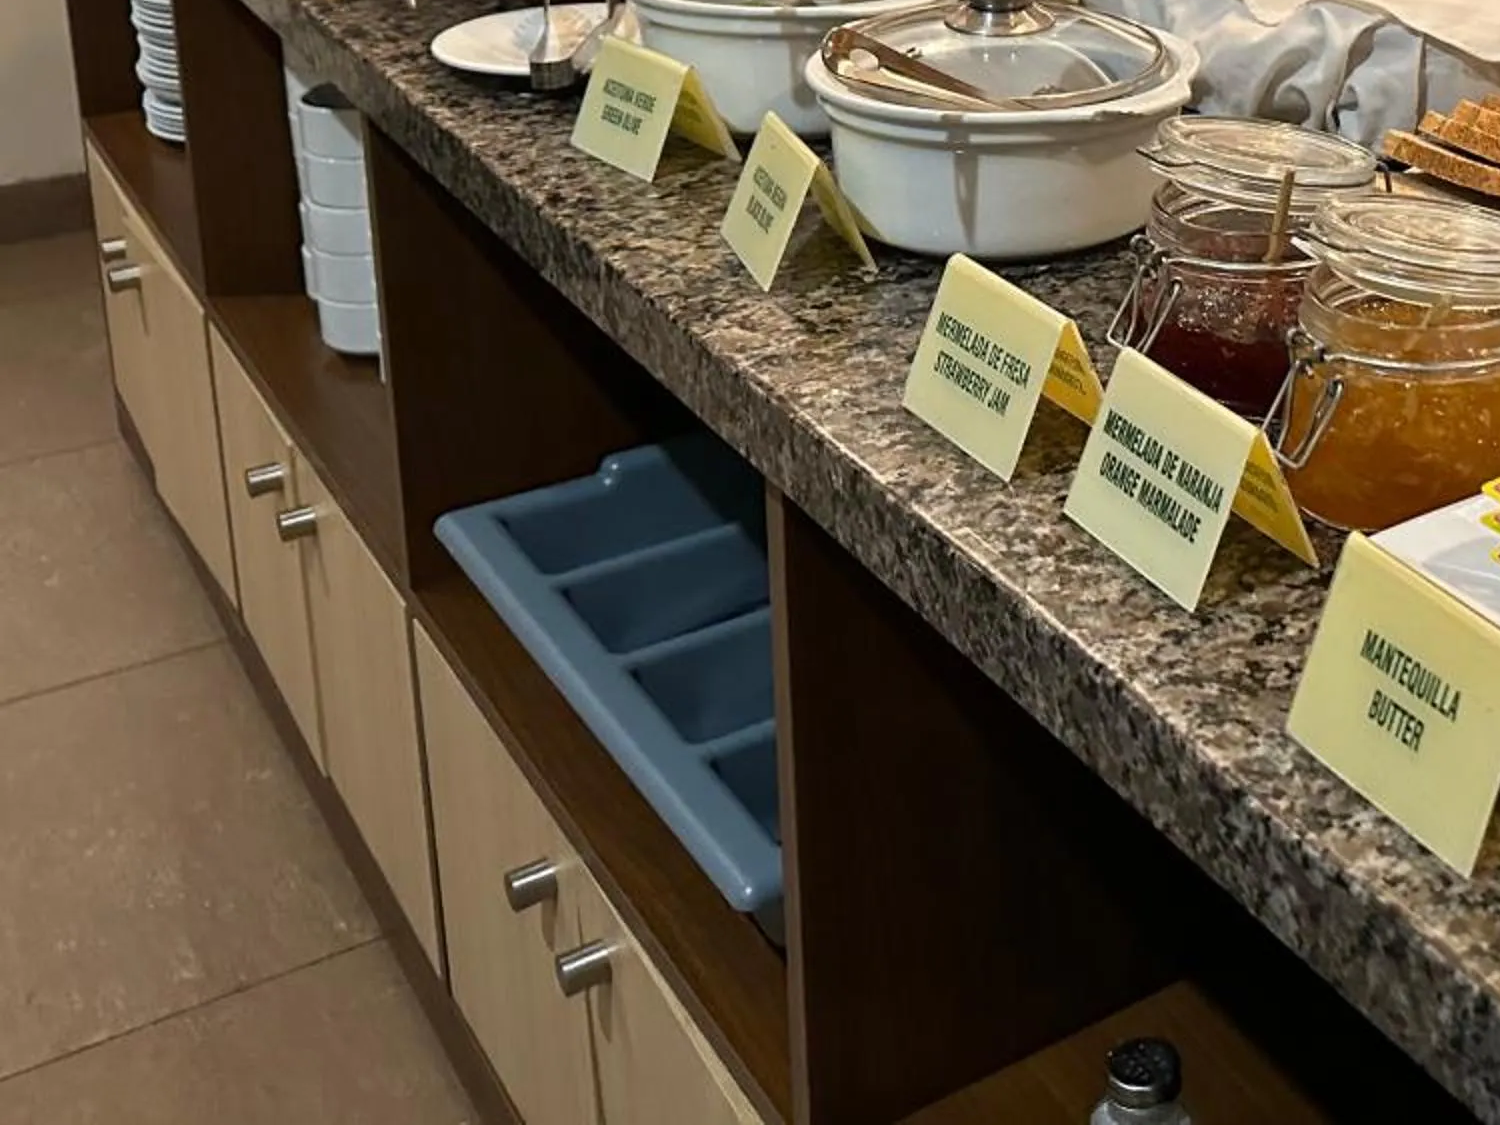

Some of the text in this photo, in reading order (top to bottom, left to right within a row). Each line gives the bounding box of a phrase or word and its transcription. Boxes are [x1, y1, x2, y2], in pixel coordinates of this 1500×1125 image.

[934, 350, 1010, 416] STRAWBERRY JAM
[936, 311, 990, 362] MERMELADA
[987, 343, 1004, 371] DE
[1000, 352, 1031, 389] FRESA
[1100, 451, 1141, 497] ORANGE
[1138, 478, 1201, 543] MARMALADE
[1103, 408, 1163, 470] MERMELADA
[1161, 450, 1180, 479] DE
[1175, 460, 1223, 514] NARANJA
[1360, 628, 1461, 723] MANTEQUILLA
[1368, 689, 1424, 751] BUTTER
